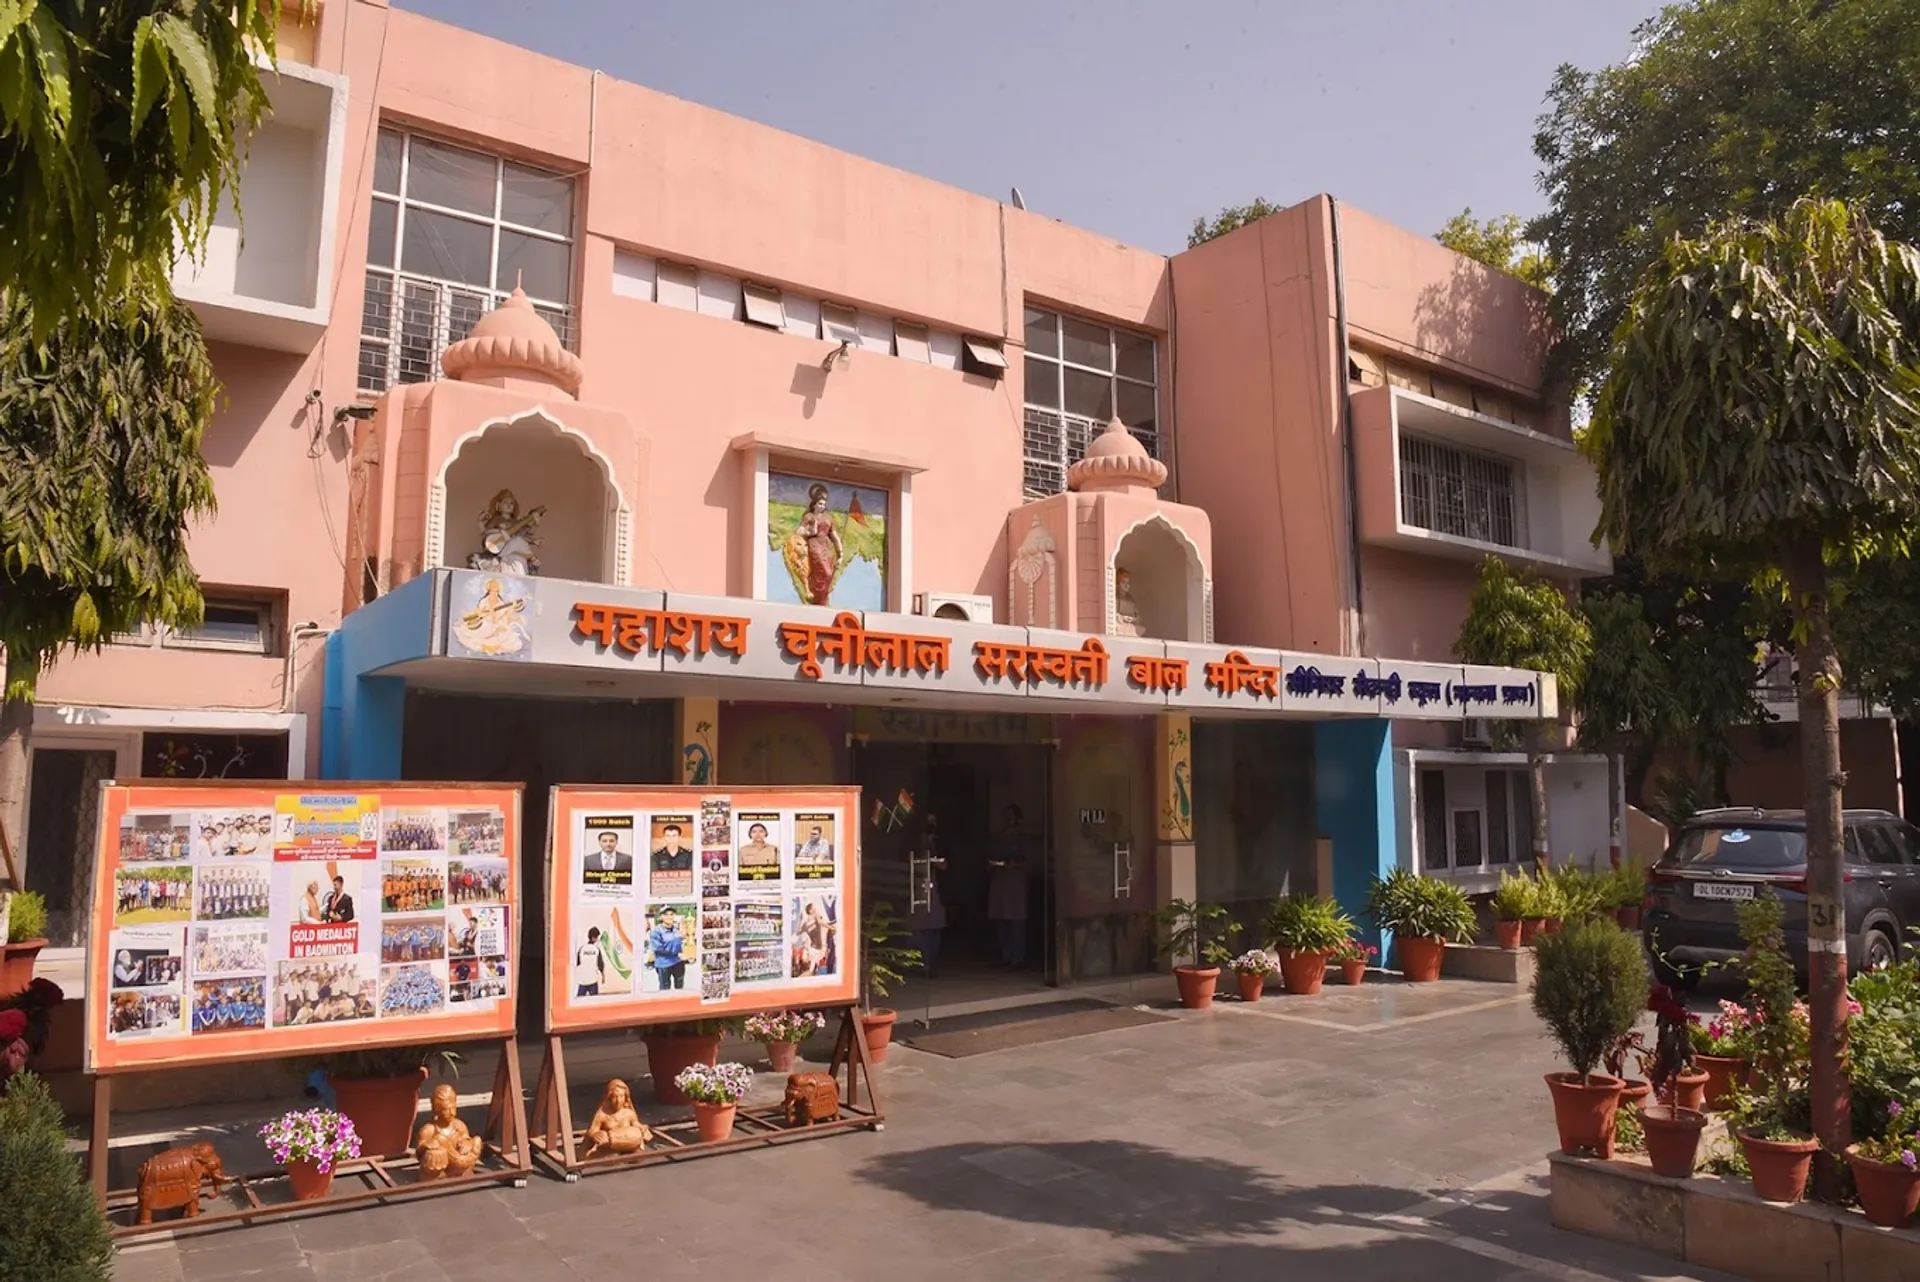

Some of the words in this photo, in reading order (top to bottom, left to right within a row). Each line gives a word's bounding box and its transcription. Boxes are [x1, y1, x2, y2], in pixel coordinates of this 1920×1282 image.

[575, 603, 751, 656] महाशय
[780, 612, 952, 680] चूनीलाल
[974, 638, 1110, 684] सरस्वती
[1127, 656, 1189, 689] बाल
[1205, 650, 1282, 697] मन्दिर
[1080, 809, 1105, 824] PULL
[292, 929, 315, 942] GOLD
[317, 927, 357, 941] MEDALIST
[294, 945, 304, 957] IN
[305, 942, 354, 957] BADMINTON
